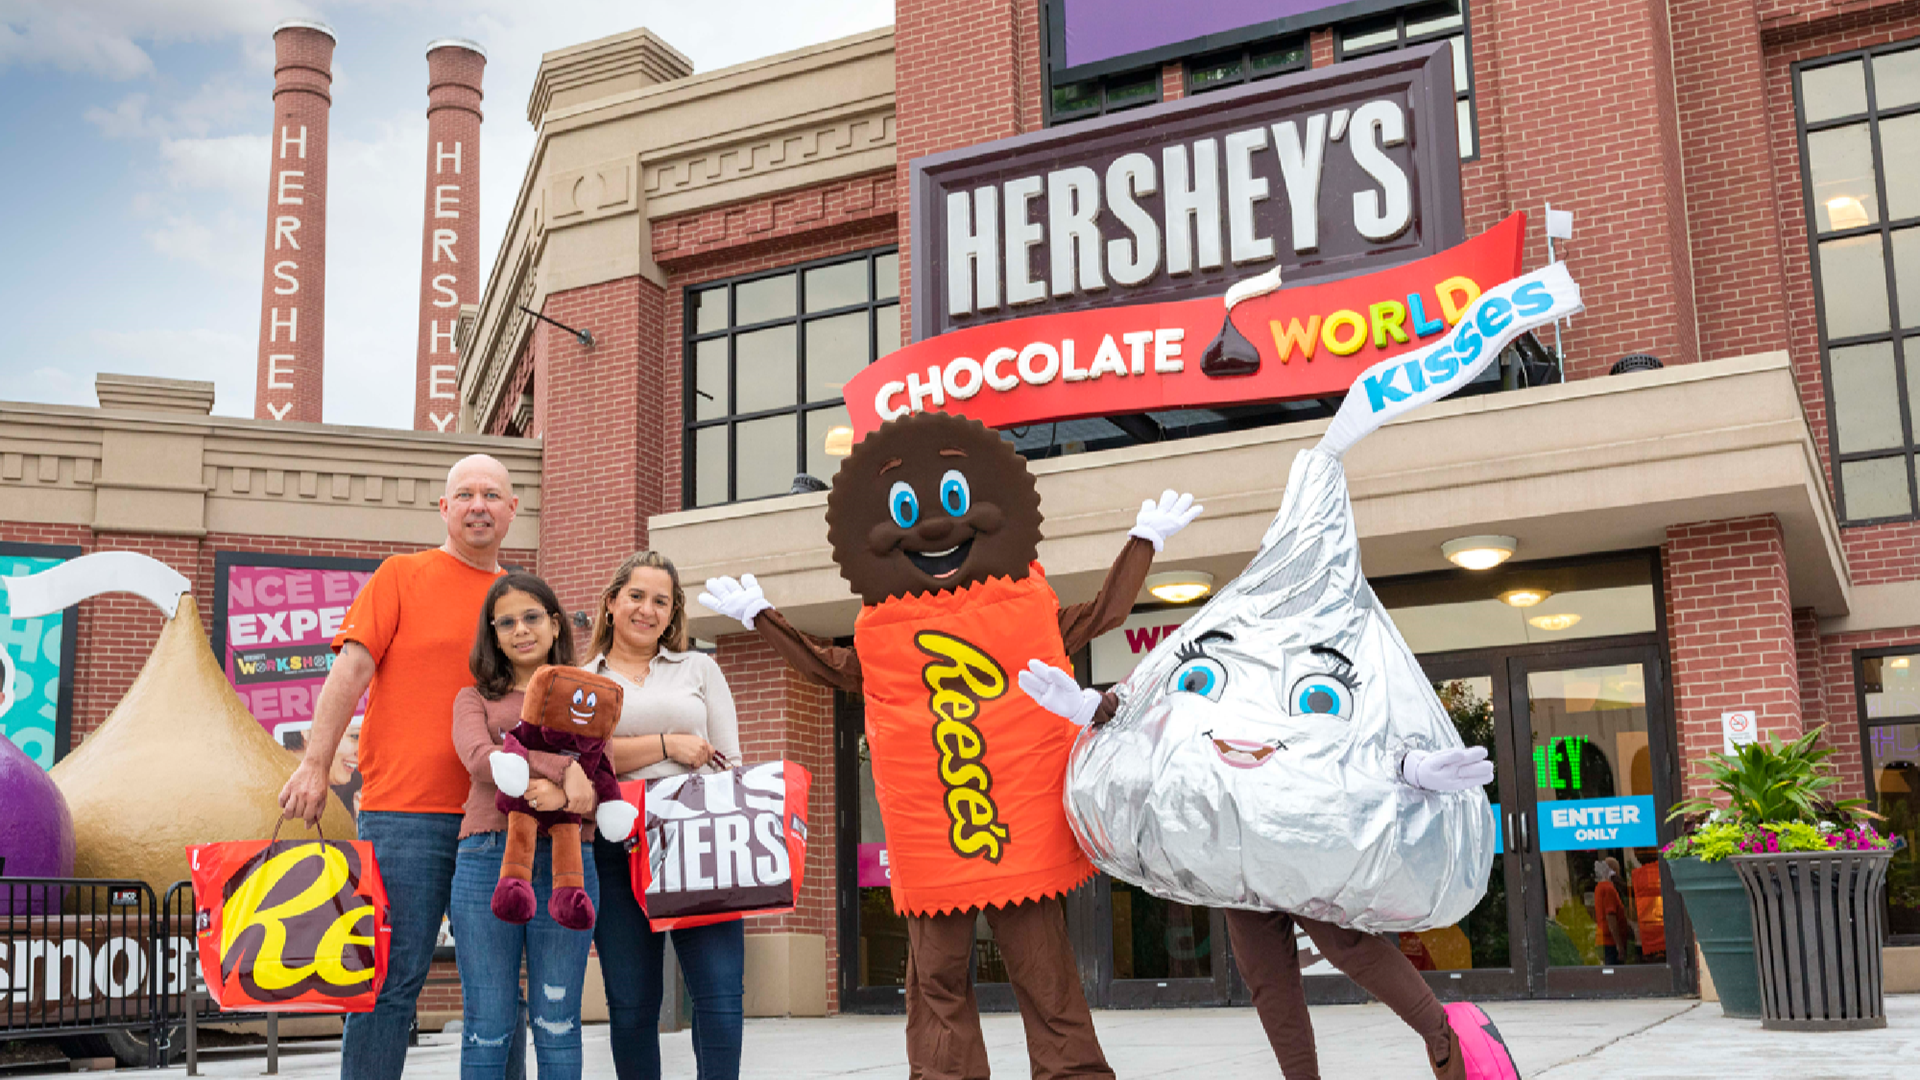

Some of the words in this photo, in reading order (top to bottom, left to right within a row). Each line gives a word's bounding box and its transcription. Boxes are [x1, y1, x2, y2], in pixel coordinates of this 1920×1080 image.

[265, 125, 307, 421] HERSHEY
[428, 141, 462, 434] HERSHEY
[946, 100, 1414, 318] HERSHEY'S
[873, 327, 1186, 423] CHOCOLATE
[1269, 275, 1482, 364] WORLD
[228, 605, 352, 646] EXPE
[916, 632, 1008, 861] Reese's
[1551, 804, 1640, 827] ENTER
[1574, 828, 1619, 842] ONLY
